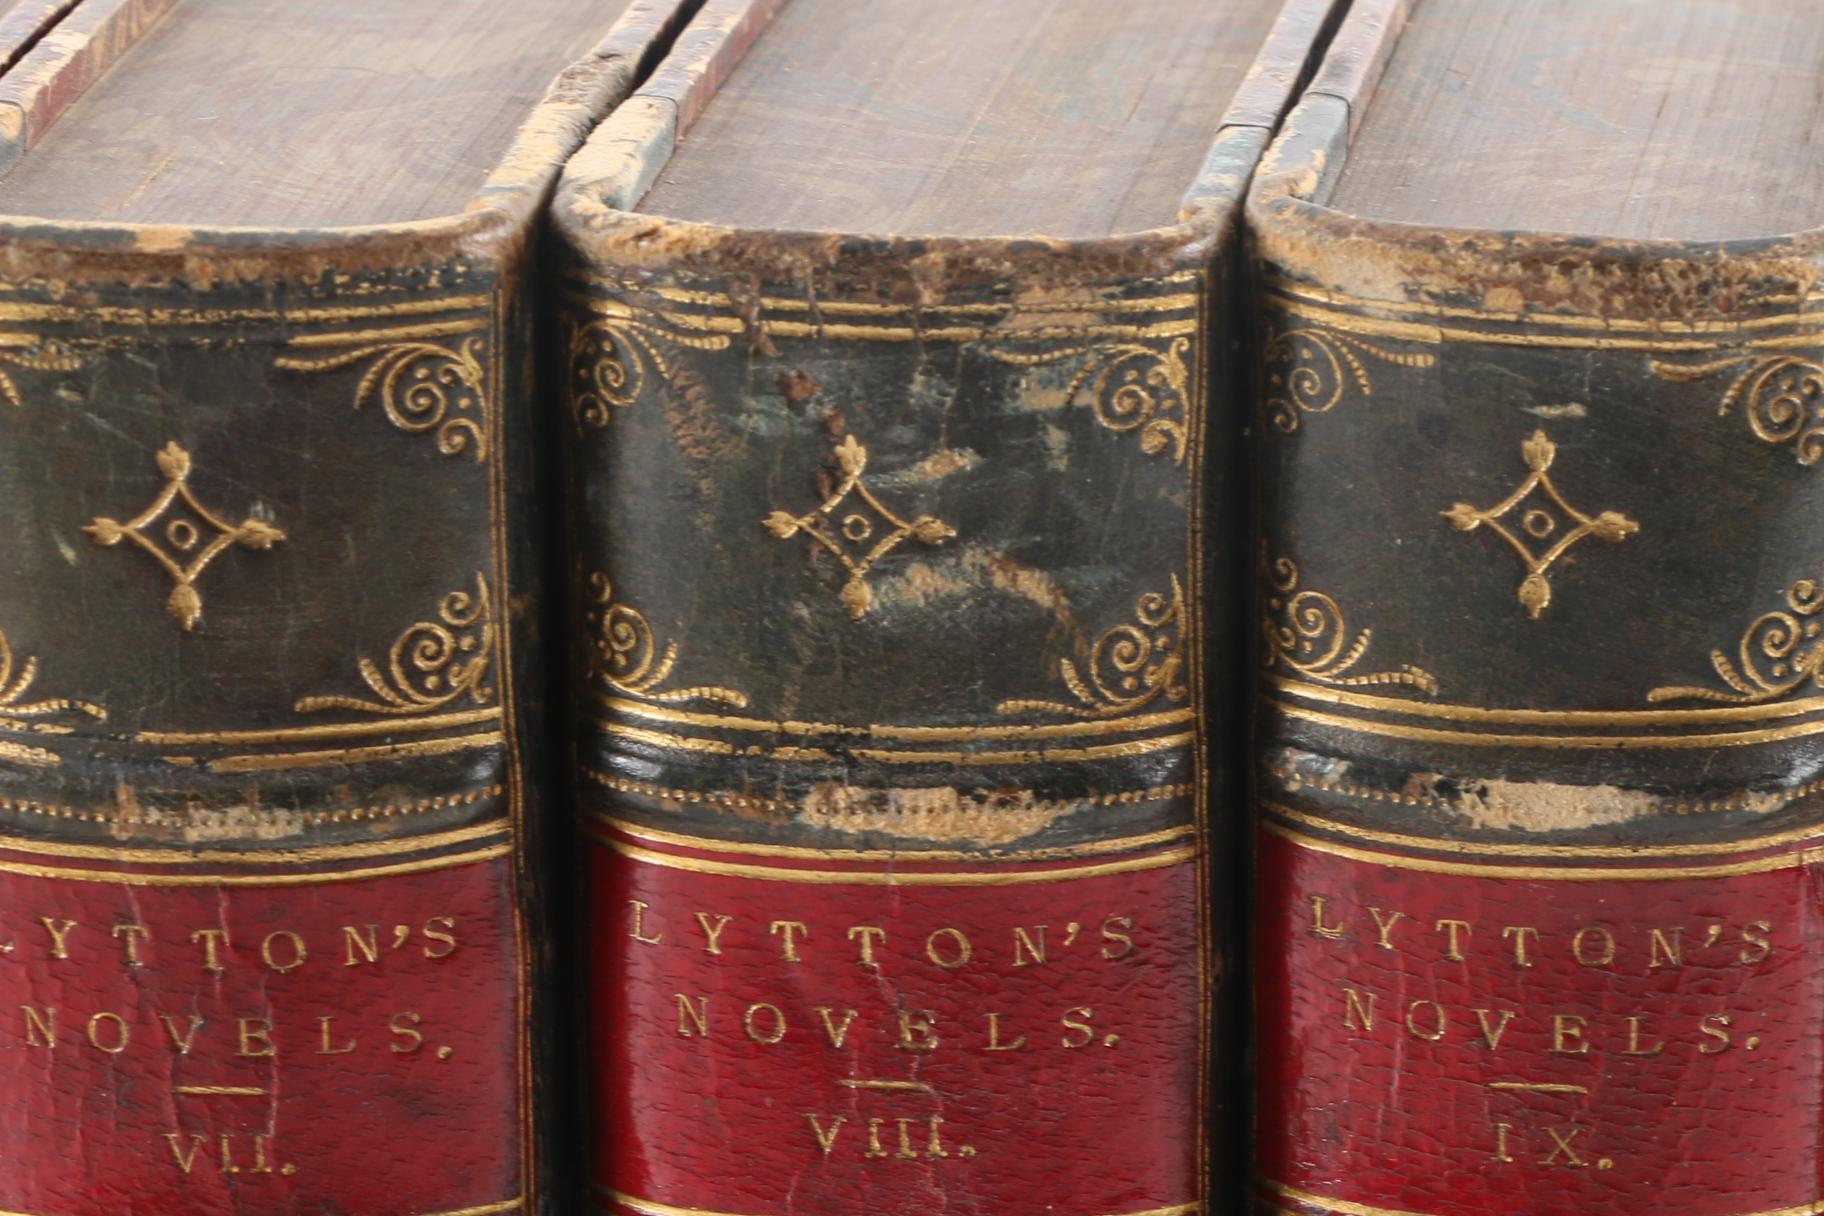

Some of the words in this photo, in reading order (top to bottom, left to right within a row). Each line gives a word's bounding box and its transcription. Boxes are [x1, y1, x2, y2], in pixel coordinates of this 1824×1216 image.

[0, 916, 457, 972] YTTON'S
[628, 900, 1135, 968] LYTTON'S
[1308, 896, 1774, 968] LYTTON'S
[20, 1005, 454, 1060] NOVELS.
[674, 994, 1121, 1050] NOVELS.
[1343, 987, 1761, 1055] NOVELS.
[162, 1133, 297, 1175] VII.
[807, 1113, 977, 1159] VIII.
[1491, 1123, 1614, 1171] IX.
